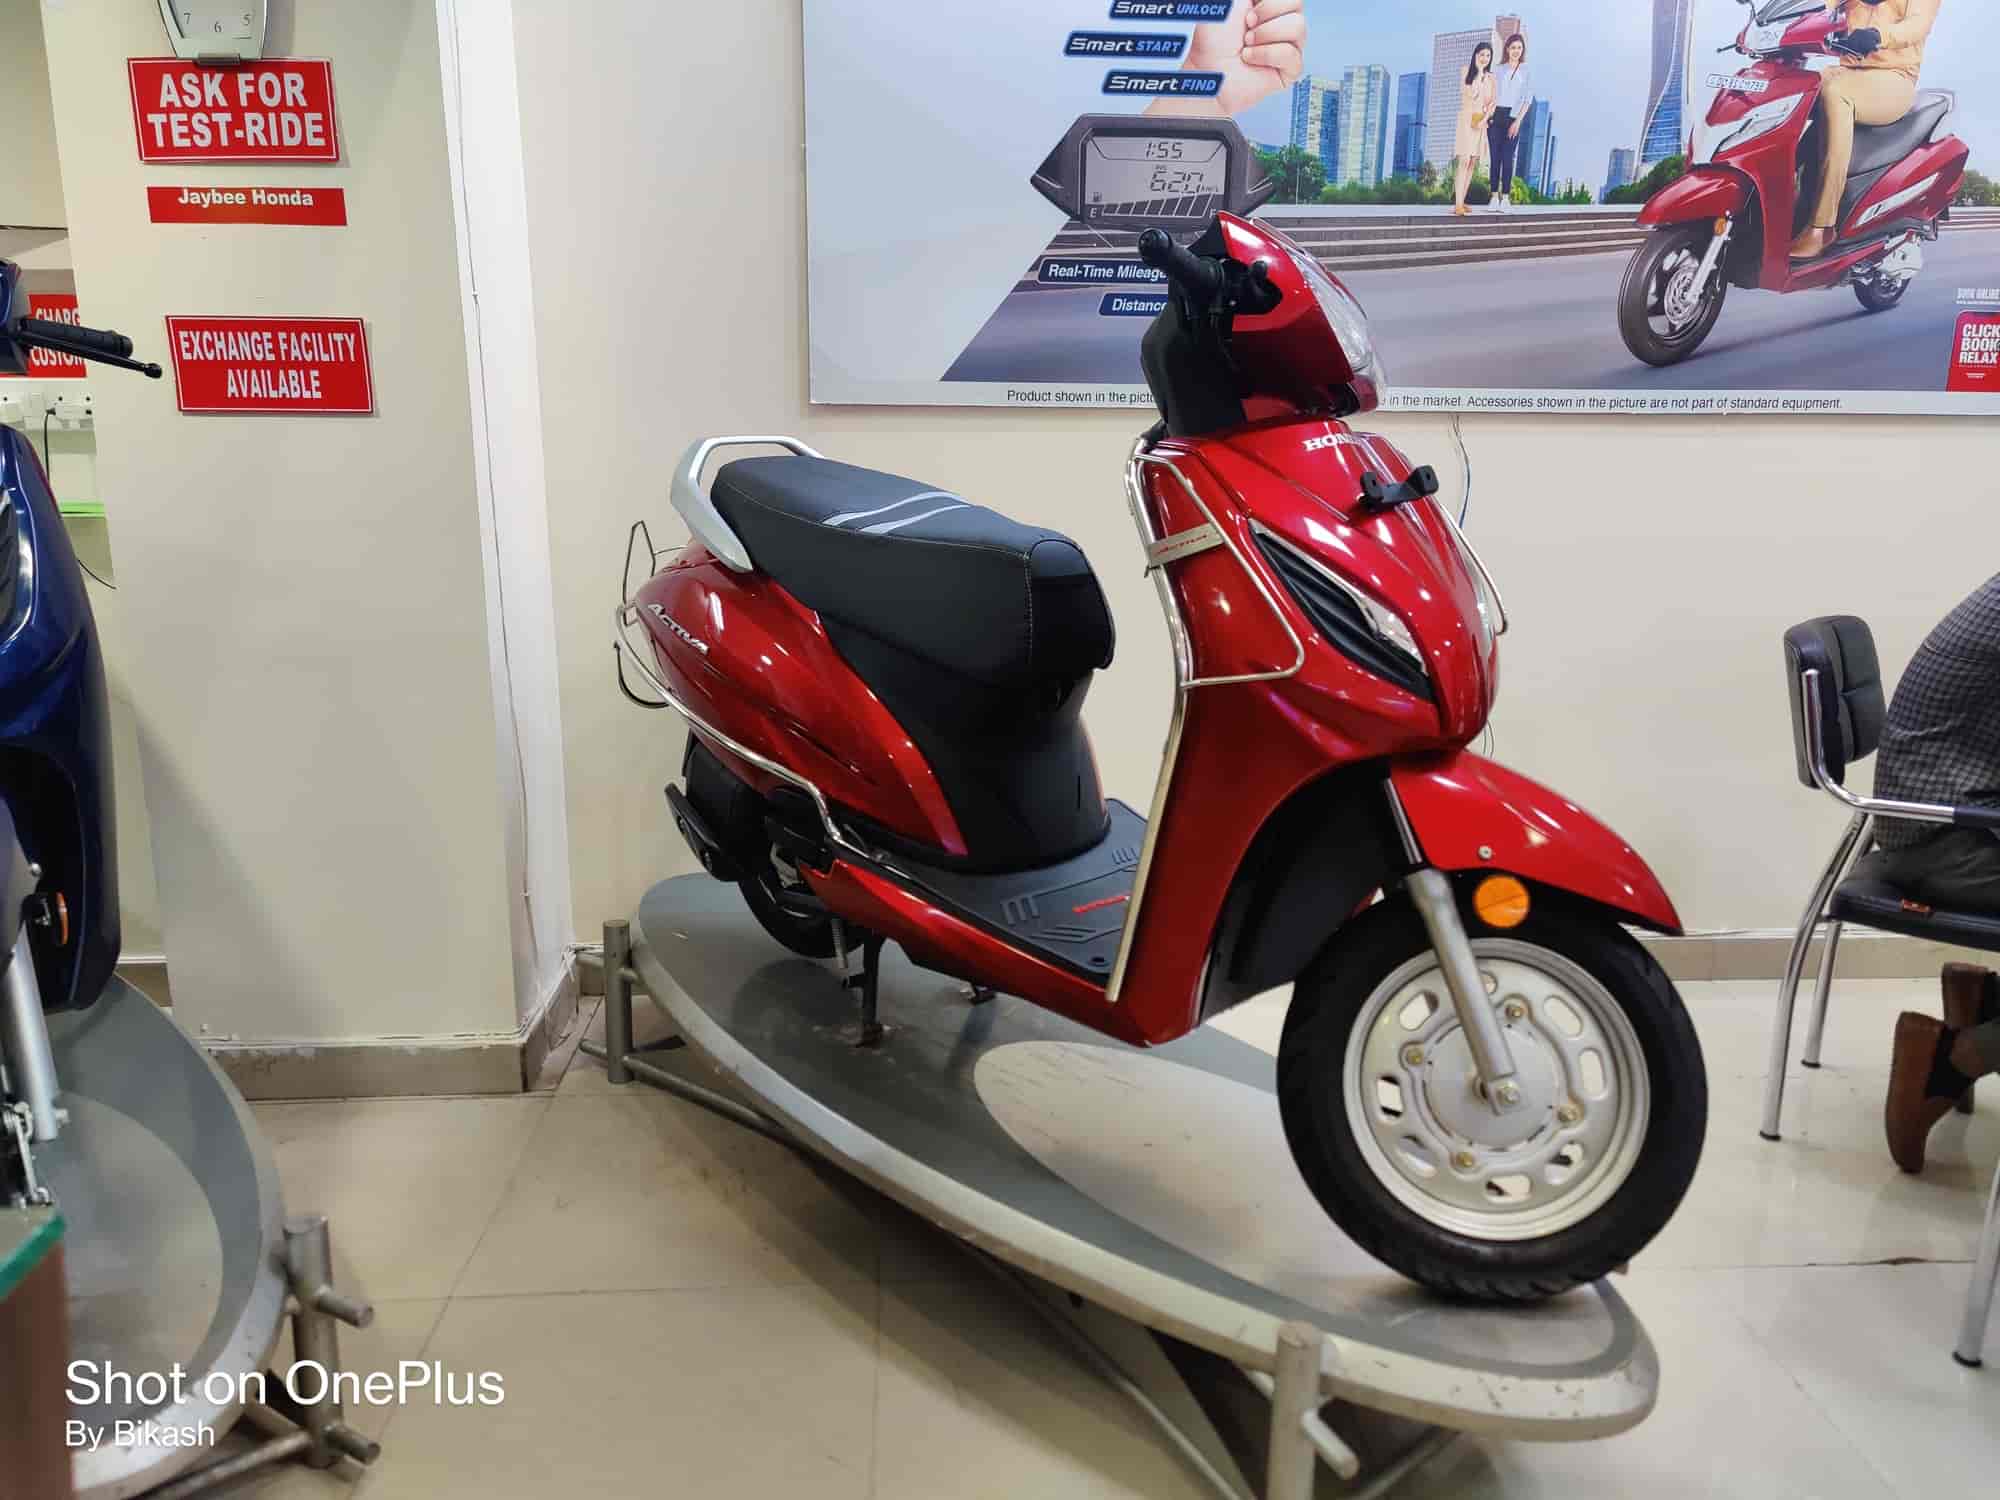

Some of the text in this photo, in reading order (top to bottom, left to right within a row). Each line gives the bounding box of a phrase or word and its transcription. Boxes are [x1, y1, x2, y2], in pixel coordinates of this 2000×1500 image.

[1114, 1, 1227, 16] Smart UNLOCK
[183, 12, 192, 25] 7
[1070, 37, 1182, 52] Smart START
[159, 72, 308, 108] ASK FOR
[1109, 75, 1217, 91] Smart FIND
[147, 112, 327, 148] TEST-RIDE
[1145, 142, 1184, 159] 1:55
[178, 188, 314, 208] Jaybee Honda
[1089, 208, 1098, 218] E
[1048, 264, 1114, 278] Real-Time
[178, 330, 356, 362] EXCHANGE FACILITY
[1959, 351, 1998, 364] RELAX
[226, 368, 322, 399] AVAILABLE
[1007, 390, 1051, 402] Product
[1055, 391, 1092, 403] shown
[1095, 391, 1105, 403] in
[1108, 391, 1126, 403] the
[1402, 395, 1421, 406] the
[1467, 396, 1533, 408] Accessories
[1536, 396, 1572, 408] shown
[1575, 397, 1585, 409] in
[1588, 397, 1606, 409] the
[1608, 397, 1647, 411] picture
[1649, 399, 1668, 409] are
[1670, 398, 1689, 409] not
[1691, 398, 1713, 412] part
[1716, 398, 1728, 409] of
[1730, 398, 1778, 409] standard
